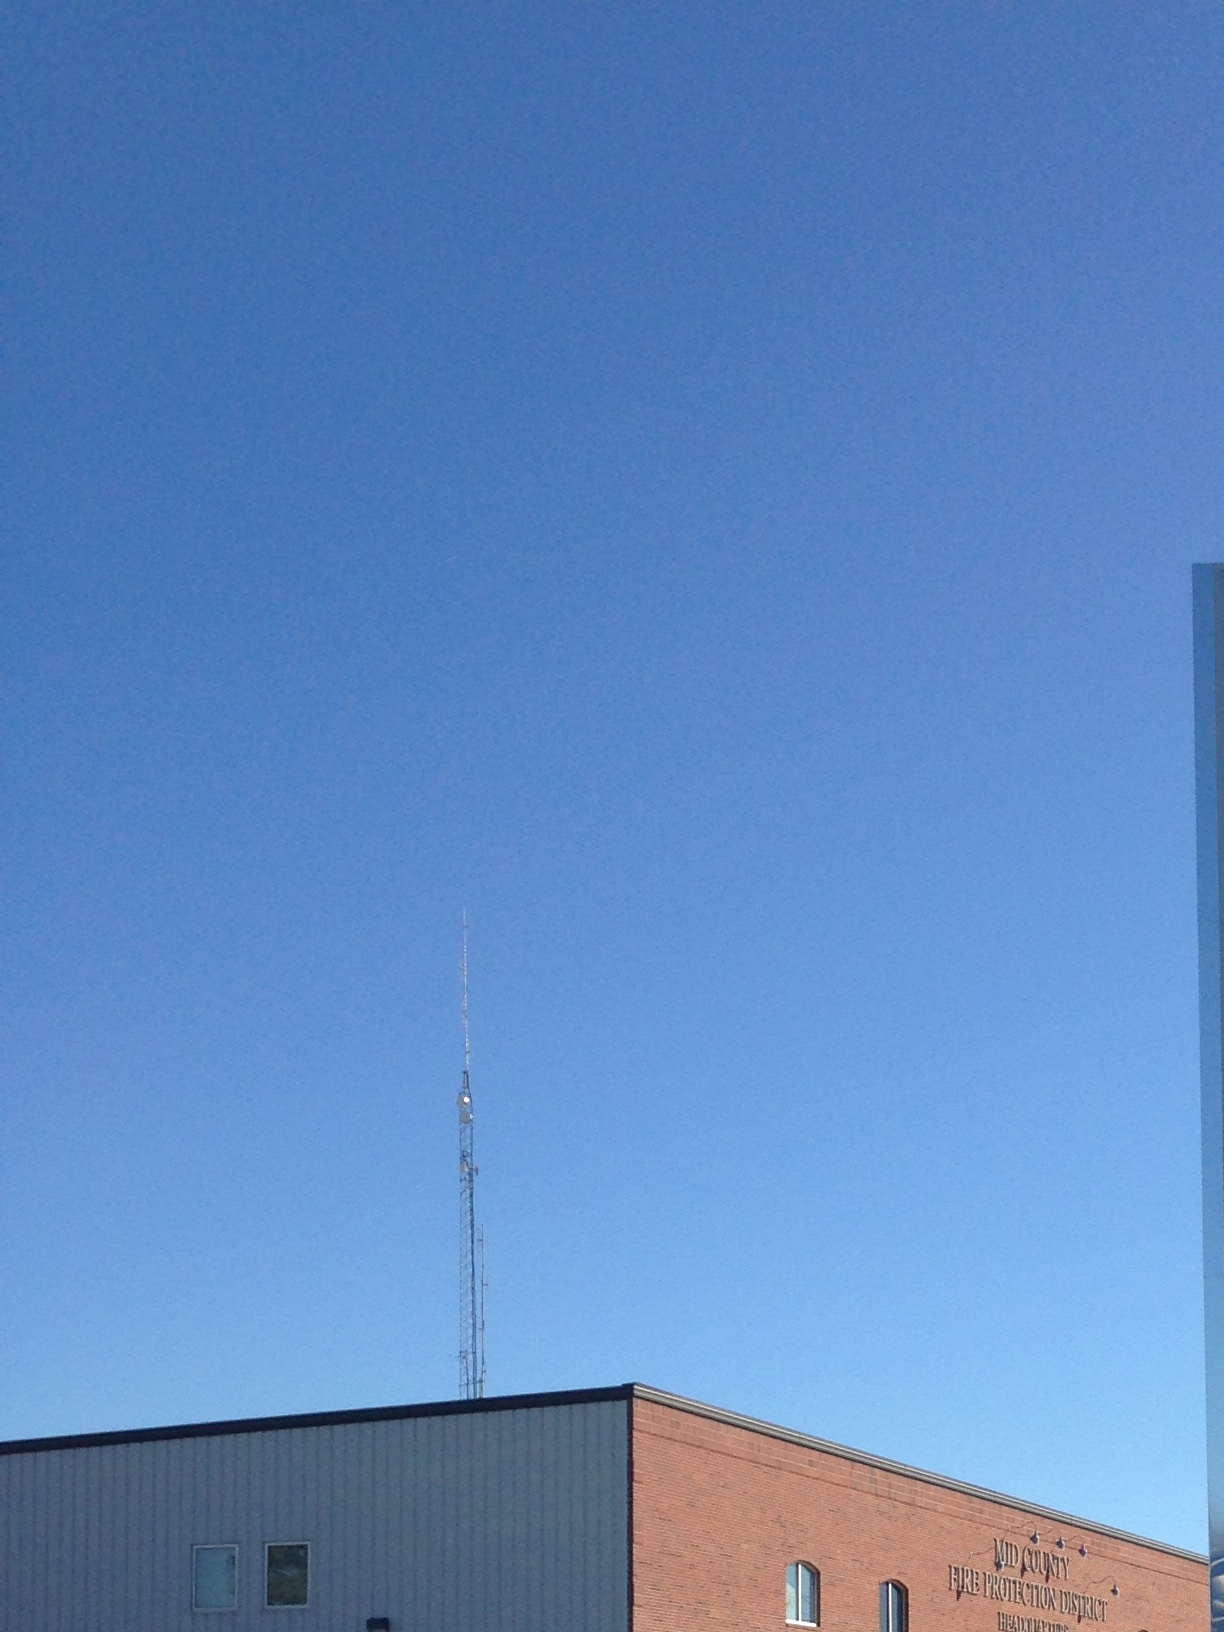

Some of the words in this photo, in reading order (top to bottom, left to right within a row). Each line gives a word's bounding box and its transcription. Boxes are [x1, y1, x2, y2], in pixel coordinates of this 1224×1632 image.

[994, 1538, 1020, 1568] MID
[1022, 1546, 1070, 1580] COUNTY
[948, 1565, 980, 1596] FIRE
[983, 1571, 1057, 1611] PROTECTION
[1059, 1589, 1108, 1622] DISTRICT
